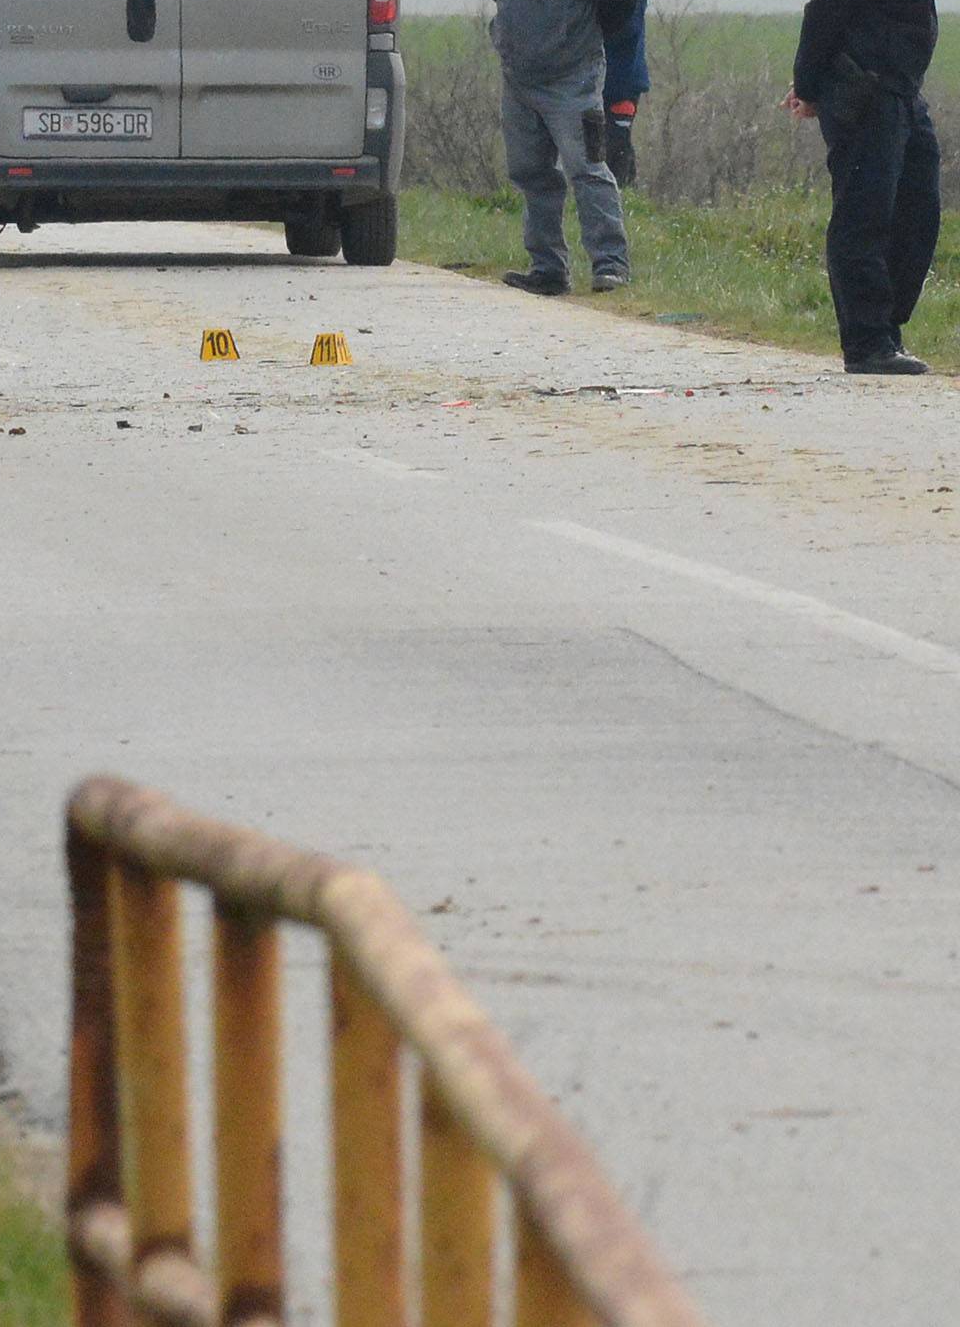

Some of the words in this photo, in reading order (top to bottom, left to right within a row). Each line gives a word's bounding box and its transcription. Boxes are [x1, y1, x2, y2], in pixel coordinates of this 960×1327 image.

[318, 66, 336, 77] HR
[38, 112, 61, 133] SB
[206, 331, 229, 357] 10
[317, 336, 331, 362] 11
